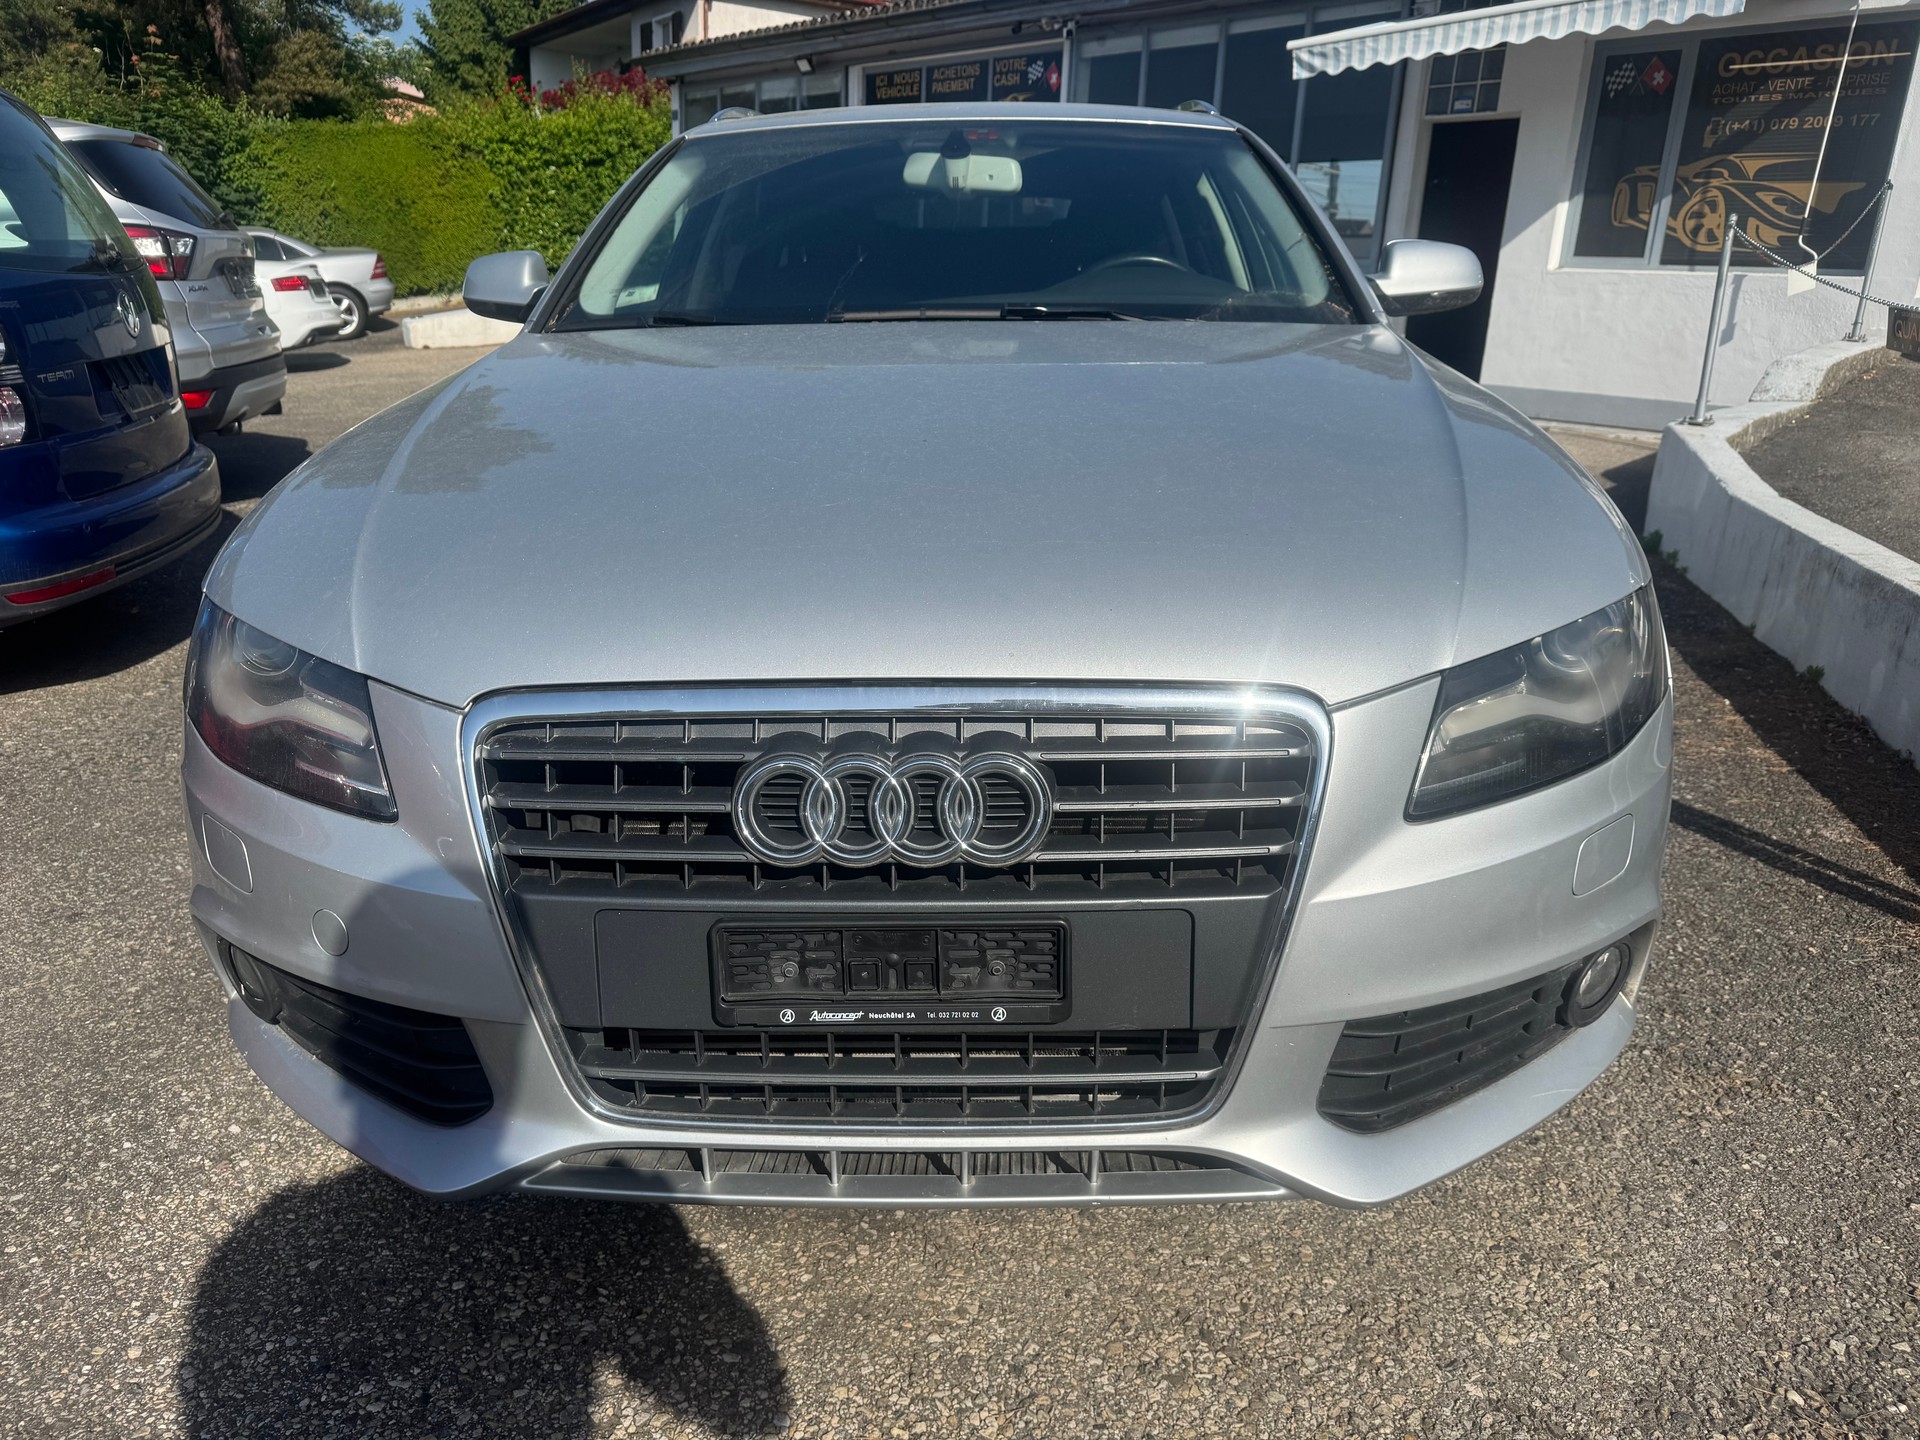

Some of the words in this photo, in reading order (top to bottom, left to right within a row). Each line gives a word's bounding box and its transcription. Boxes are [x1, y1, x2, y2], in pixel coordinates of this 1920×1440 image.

[1718, 39, 1899, 77] OCCASION
[876, 75, 888, 87] ICI
[894, 71, 920, 83] NOUS
[933, 64, 980, 80] ACHETONS
[994, 58, 1028, 73] VOTRE
[1712, 81, 1757, 96] ACHAT
[1768, 77, 1815, 91] VENTE
[1826, 72, 1892, 88] RPRISE
[876, 84, 920, 99] VEHICULE
[932, 78, 975, 93] PAIEMENT
[993, 73, 1021, 88] CASH
[1712, 93, 1783, 105] TOUTES
[1788, 87, 1888, 100] MARQUES
[1725, 119, 1765, 136] (+41)
[1770, 117, 1799, 131] 079
[1850, 113, 1881, 127] 177
[1894, 318, 1920, 342] QUA
[36, 369, 75, 383] TEAM
[809, 1010, 865, 1022] Autoconcept
[868, 1011, 905, 1020] Neuchâtel
[926, 1011, 937, 1019] Tel.
